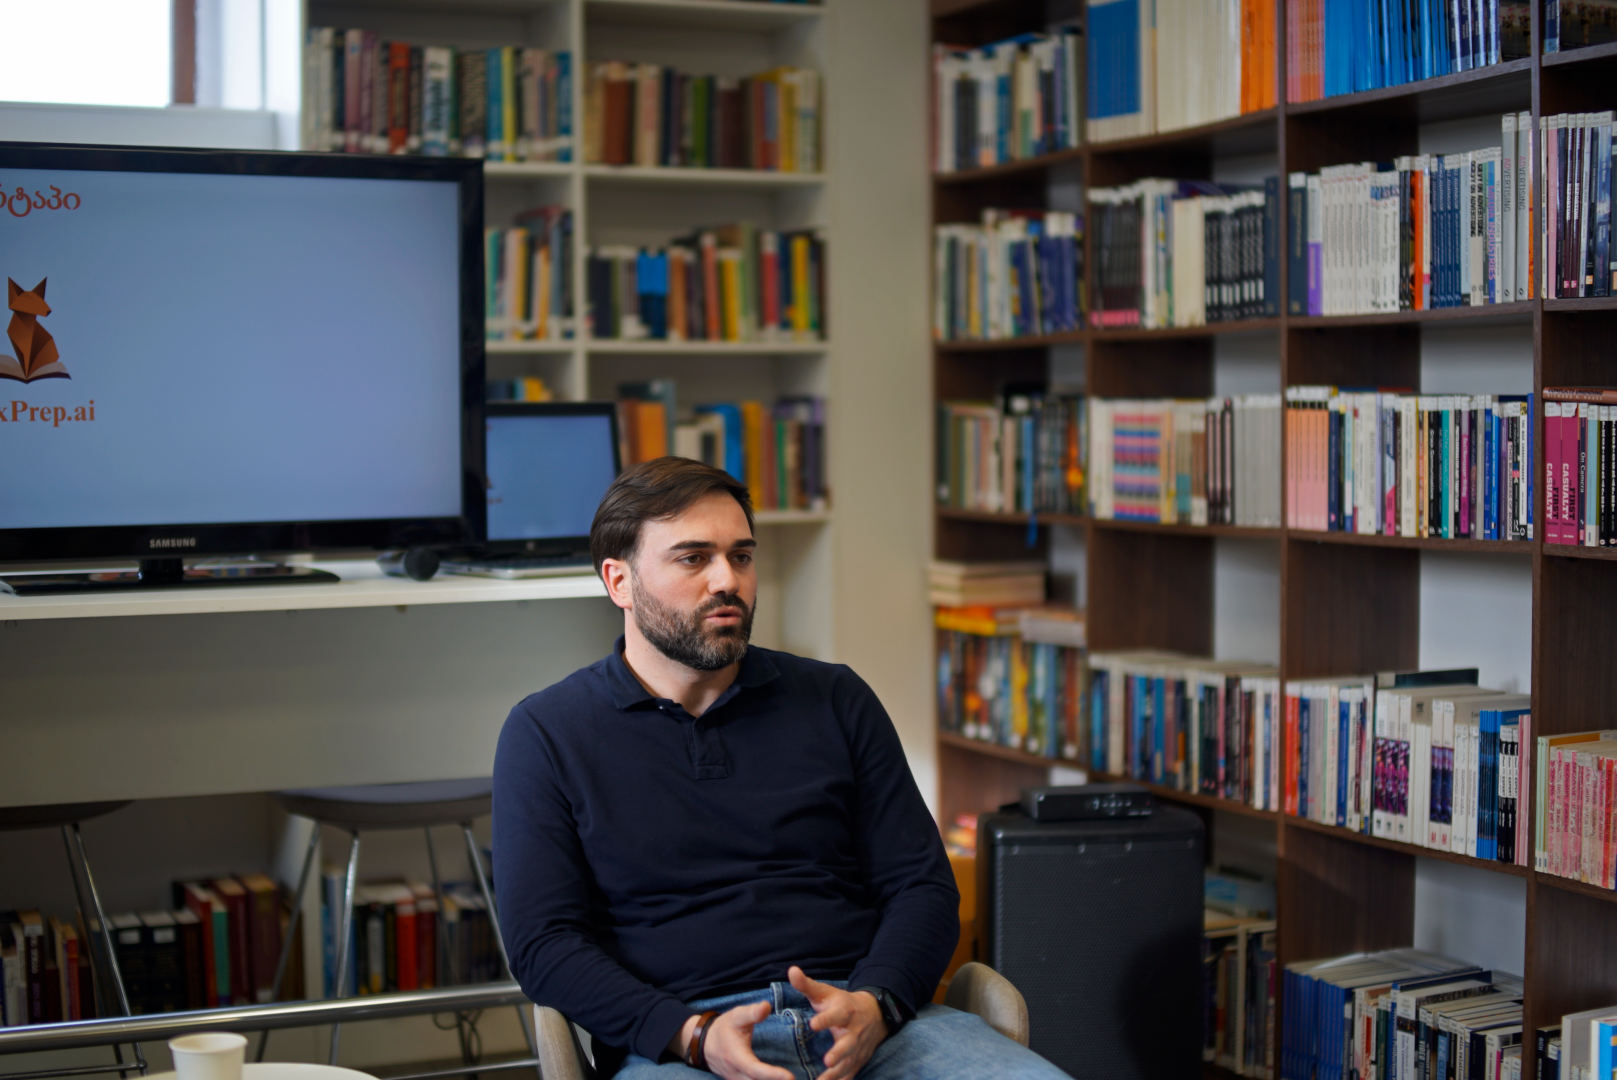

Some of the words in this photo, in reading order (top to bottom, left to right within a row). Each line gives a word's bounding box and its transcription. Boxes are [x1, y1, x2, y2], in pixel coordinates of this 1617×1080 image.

[1518, 156, 1526, 210] ADVERTISING
[0, 183, 81, 217] ტაპი
[1581, 452, 1586, 462] On
[149, 538, 196, 548] SAMSUNG
